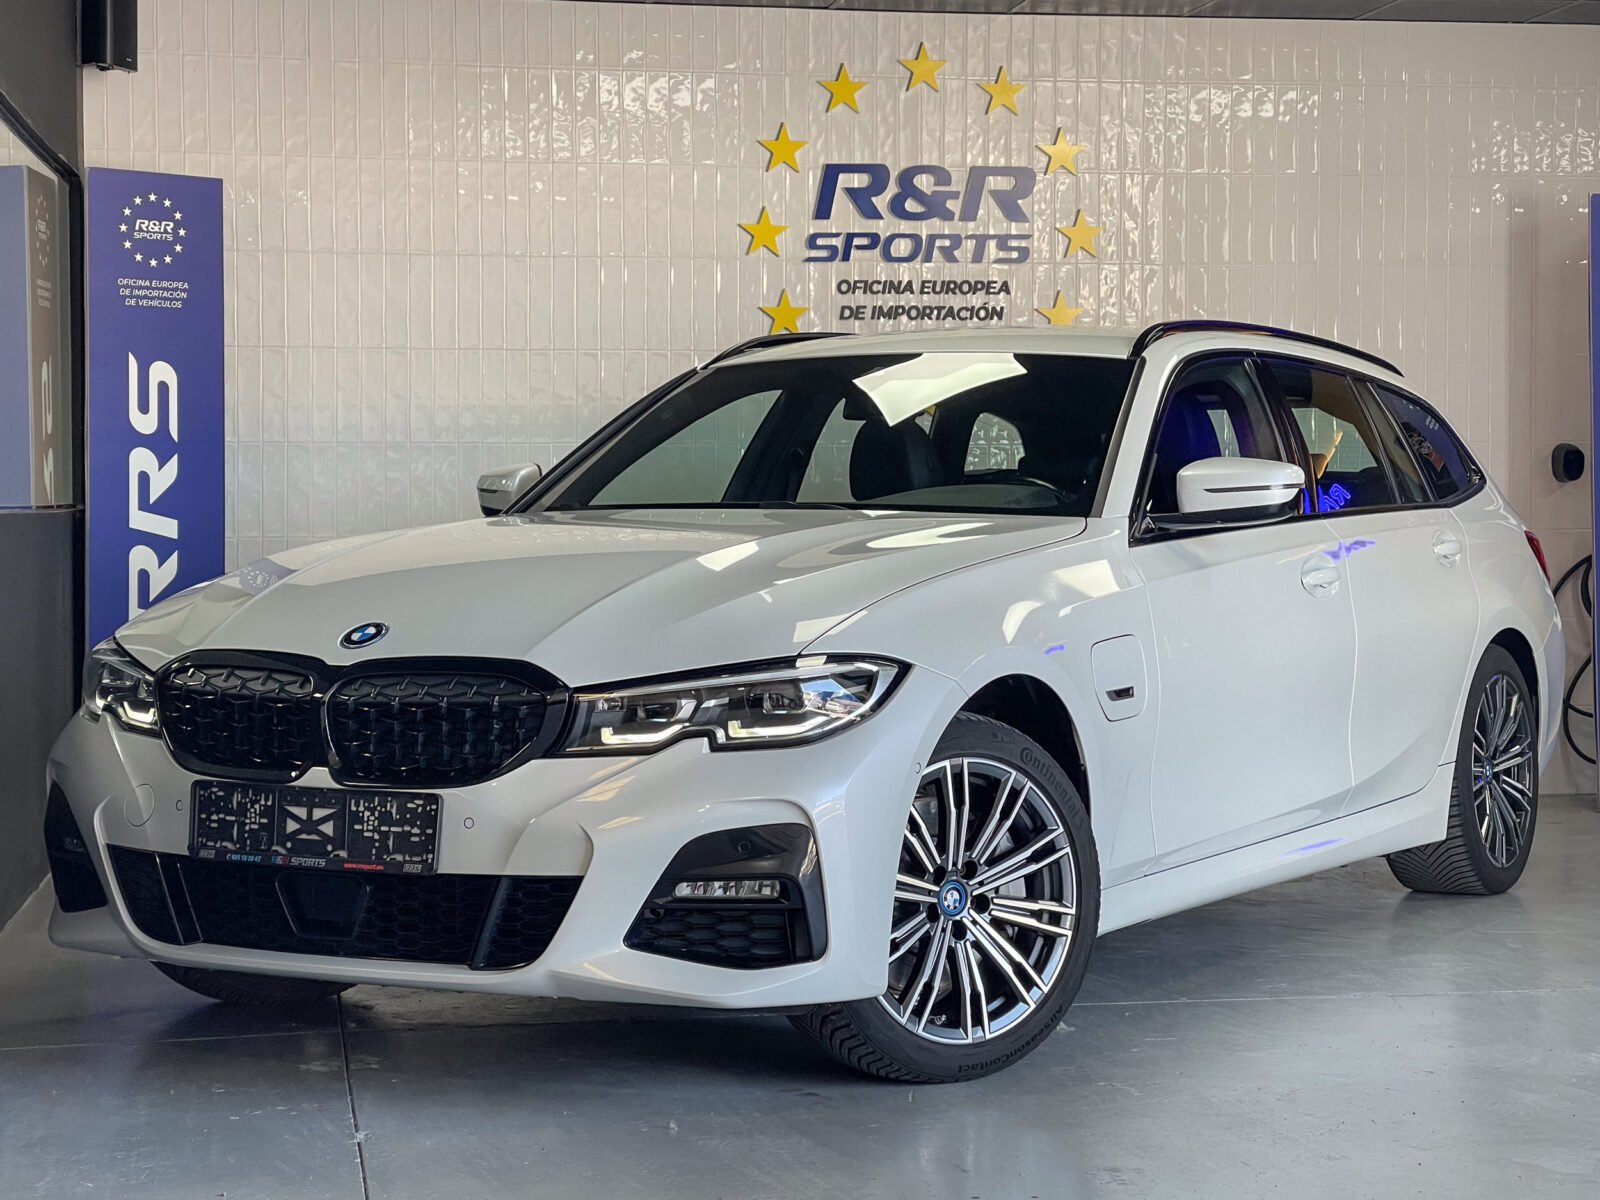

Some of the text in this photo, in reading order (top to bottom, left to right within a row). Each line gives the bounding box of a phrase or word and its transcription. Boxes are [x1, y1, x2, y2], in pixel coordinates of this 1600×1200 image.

[812, 163, 1037, 223] R&R
[134, 219, 174, 233] R&R
[133, 231, 174, 241] SPORTS
[802, 231, 1034, 264] SPORTS
[117, 278, 189, 290] OFICINA EUROPEA
[836, 279, 1011, 296] OFICINA EUROPEA
[119, 288, 187, 299] DE IMPORTACIÓN
[125, 298, 183, 308] DE VEHÍCULOS
[839, 302, 1004, 321] DE IMPORTACIÓN
[128, 351, 178, 621] RRS
[1020, 747, 1078, 818] Continental
[290, 857, 327, 868] SPORTS
